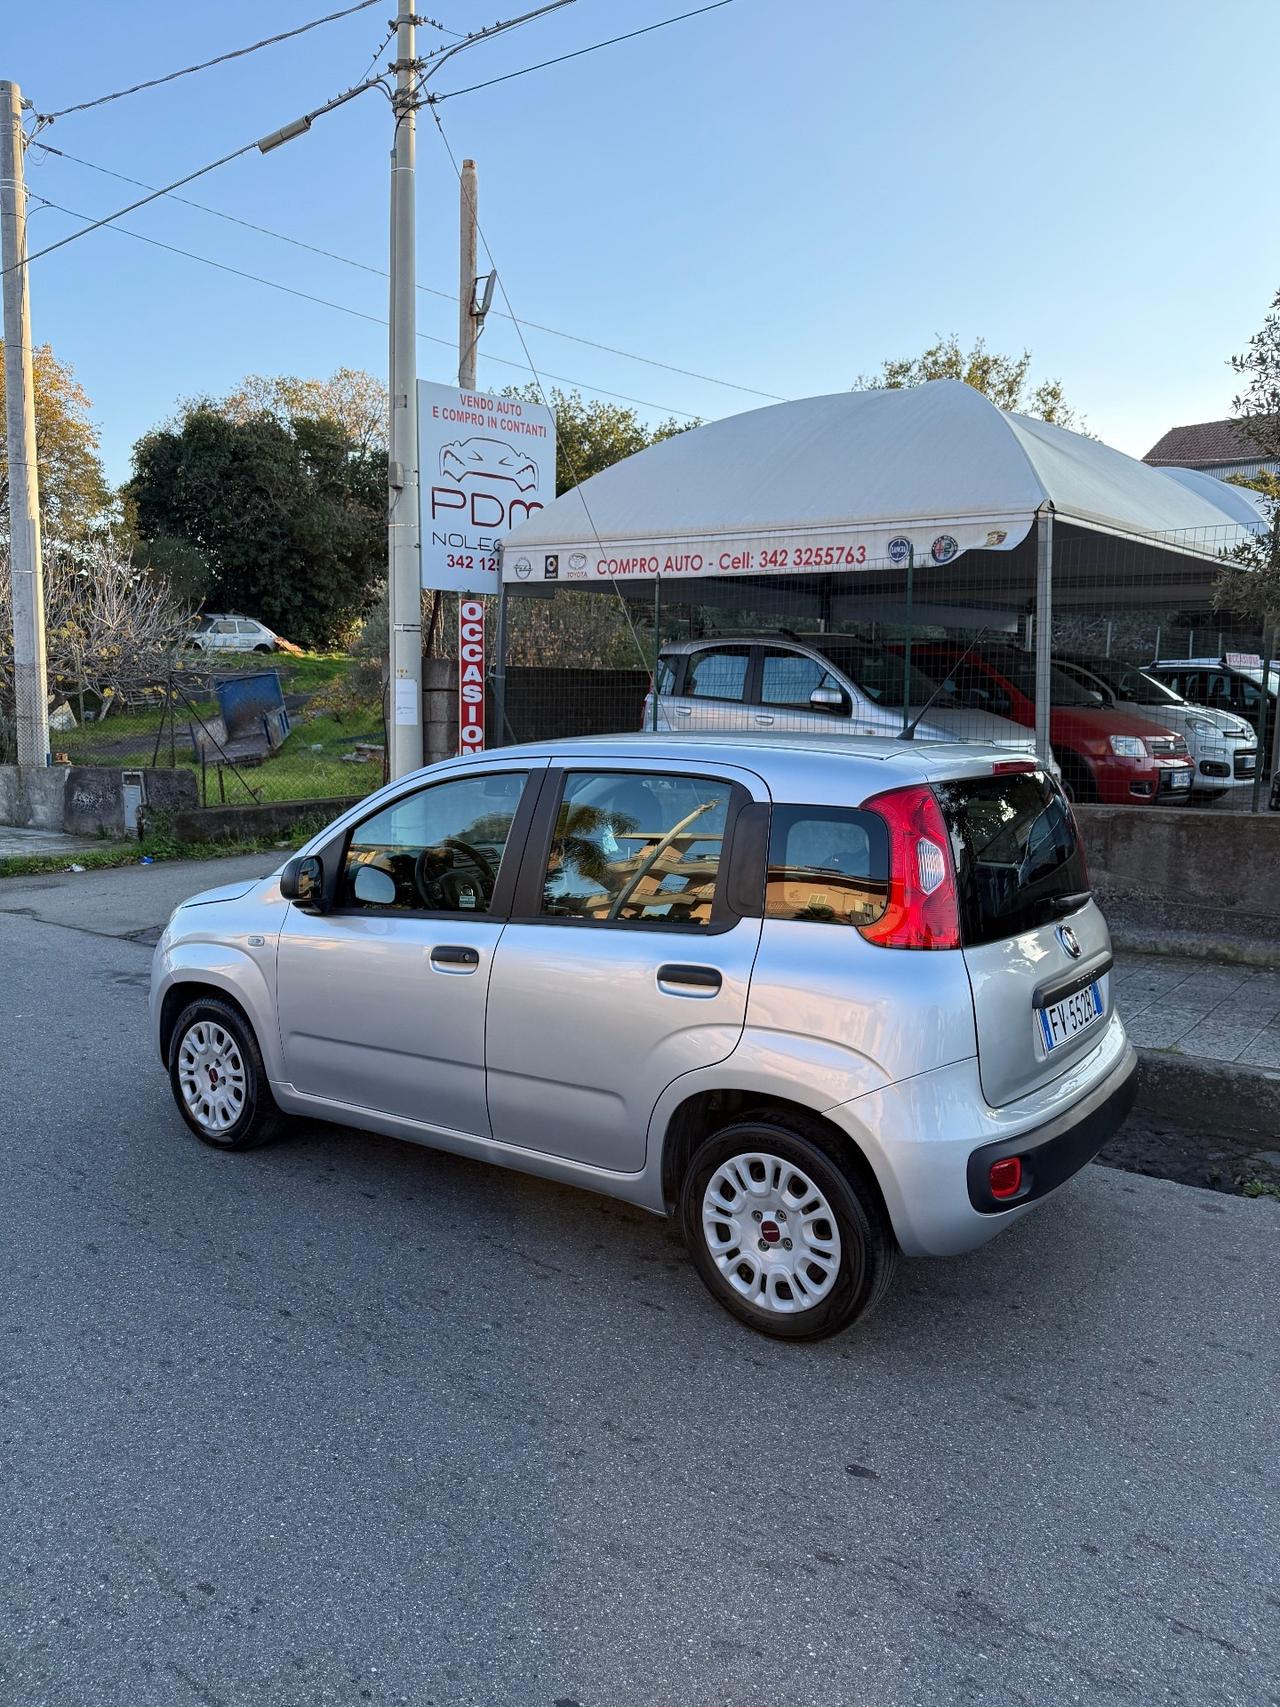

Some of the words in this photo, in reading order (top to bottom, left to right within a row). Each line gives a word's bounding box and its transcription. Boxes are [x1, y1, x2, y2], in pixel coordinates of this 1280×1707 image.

[460, 394, 493, 411] VENDO
[496, 402, 522, 416] AUTO
[432, 406, 439, 418] E
[442, 408, 484, 426] COMPRO
[487, 416, 497, 428] IN
[500, 418, 547, 438] CONTANTI
[447, 554, 474, 569] 342
[479, 557, 500, 571] 12
[597, 556, 659, 575] COMPRO
[663, 554, 703, 572] AUTO
[719, 551, 754, 570] Cell:
[759, 549, 788, 568] 342
[793, 545, 866, 566] 3255763
